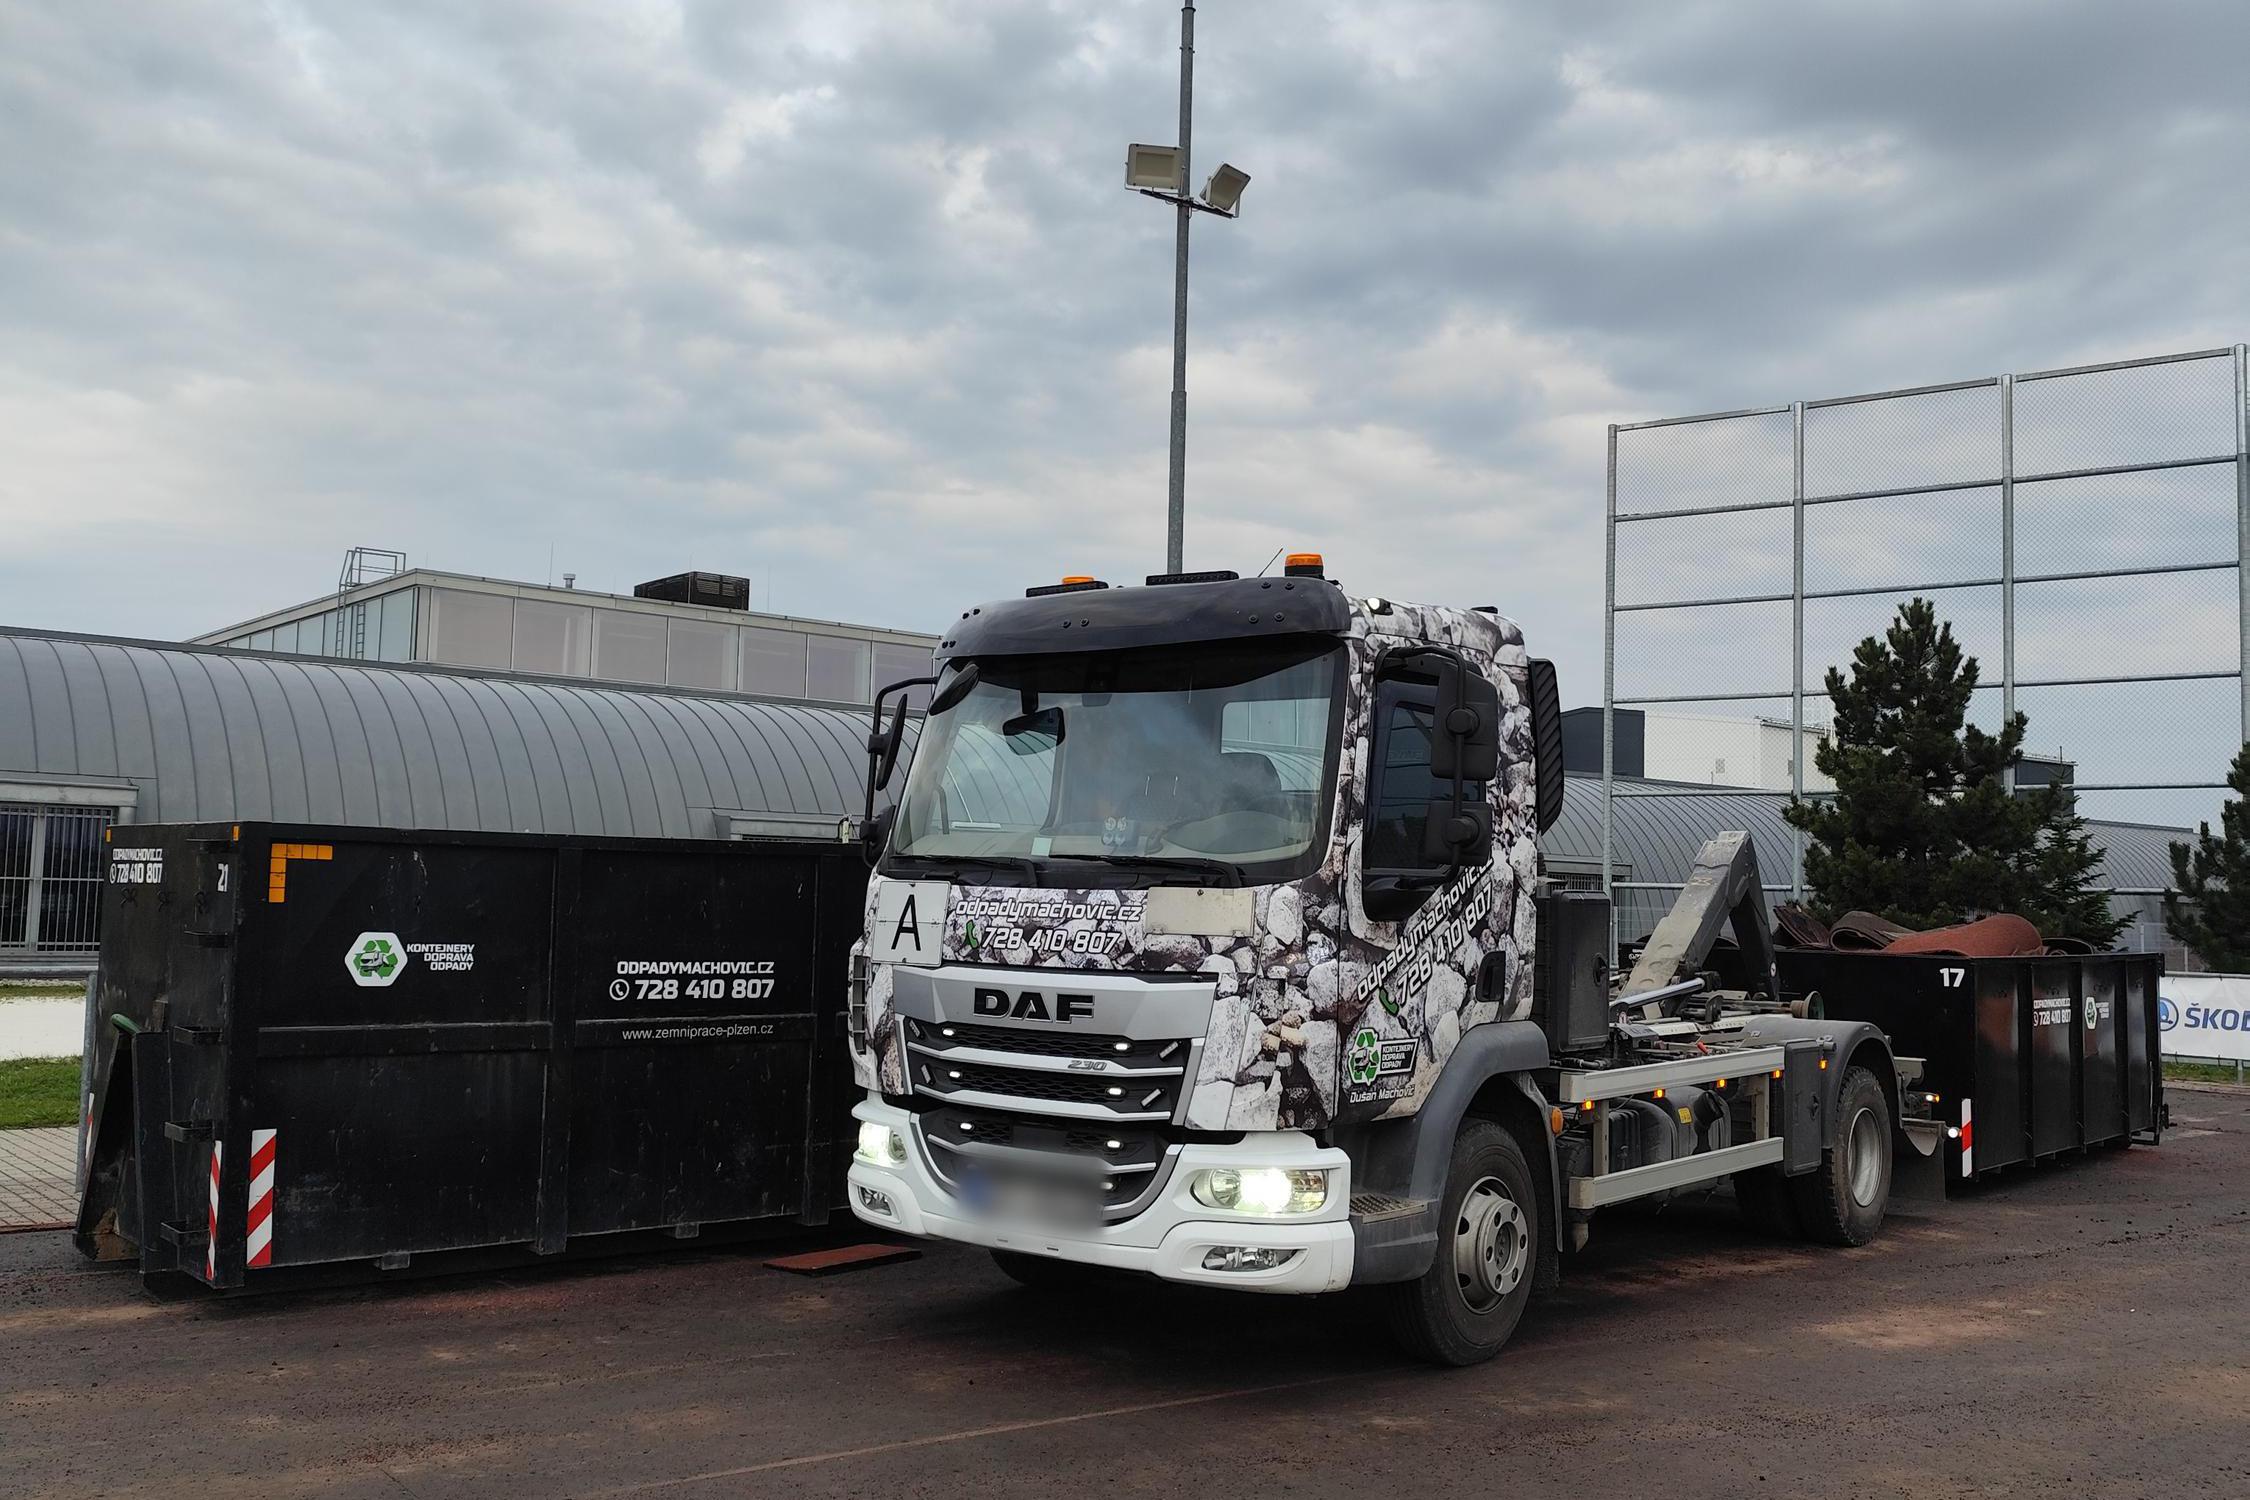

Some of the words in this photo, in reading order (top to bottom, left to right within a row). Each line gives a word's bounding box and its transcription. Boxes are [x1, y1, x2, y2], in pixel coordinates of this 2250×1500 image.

[117, 863, 130, 883] 728
[129, 863, 145, 883] 410
[146, 863, 163, 883] 807
[217, 863, 229, 892] 21
[955, 899, 1145, 922] odpadymachovic.cz
[891, 894, 922, 951] A
[406, 943, 475, 953] KONTEJNERY
[980, 926, 1024, 950] 728
[1027, 929, 1067, 952] 410
[1072, 931, 1121, 954] 807
[1398, 951, 1433, 1006] 728
[1436, 918, 1464, 963] 410
[1465, 882, 1493, 932] 807
[423, 952, 475, 962] DOPRAVA
[429, 961, 474, 971] ODPADY
[617, 961, 775, 975] ODPADYMACHOVIC.CZ
[1939, 967, 1965, 988] 17
[635, 979, 679, 1000] 728
[685, 979, 725, 999] 410
[731, 979, 775, 999] 807
[973, 987, 1096, 1024] DAF
[622, 1024, 774, 1040] www.zemniprace-plzen.cz
[1067, 1059, 1108, 1071] 230
